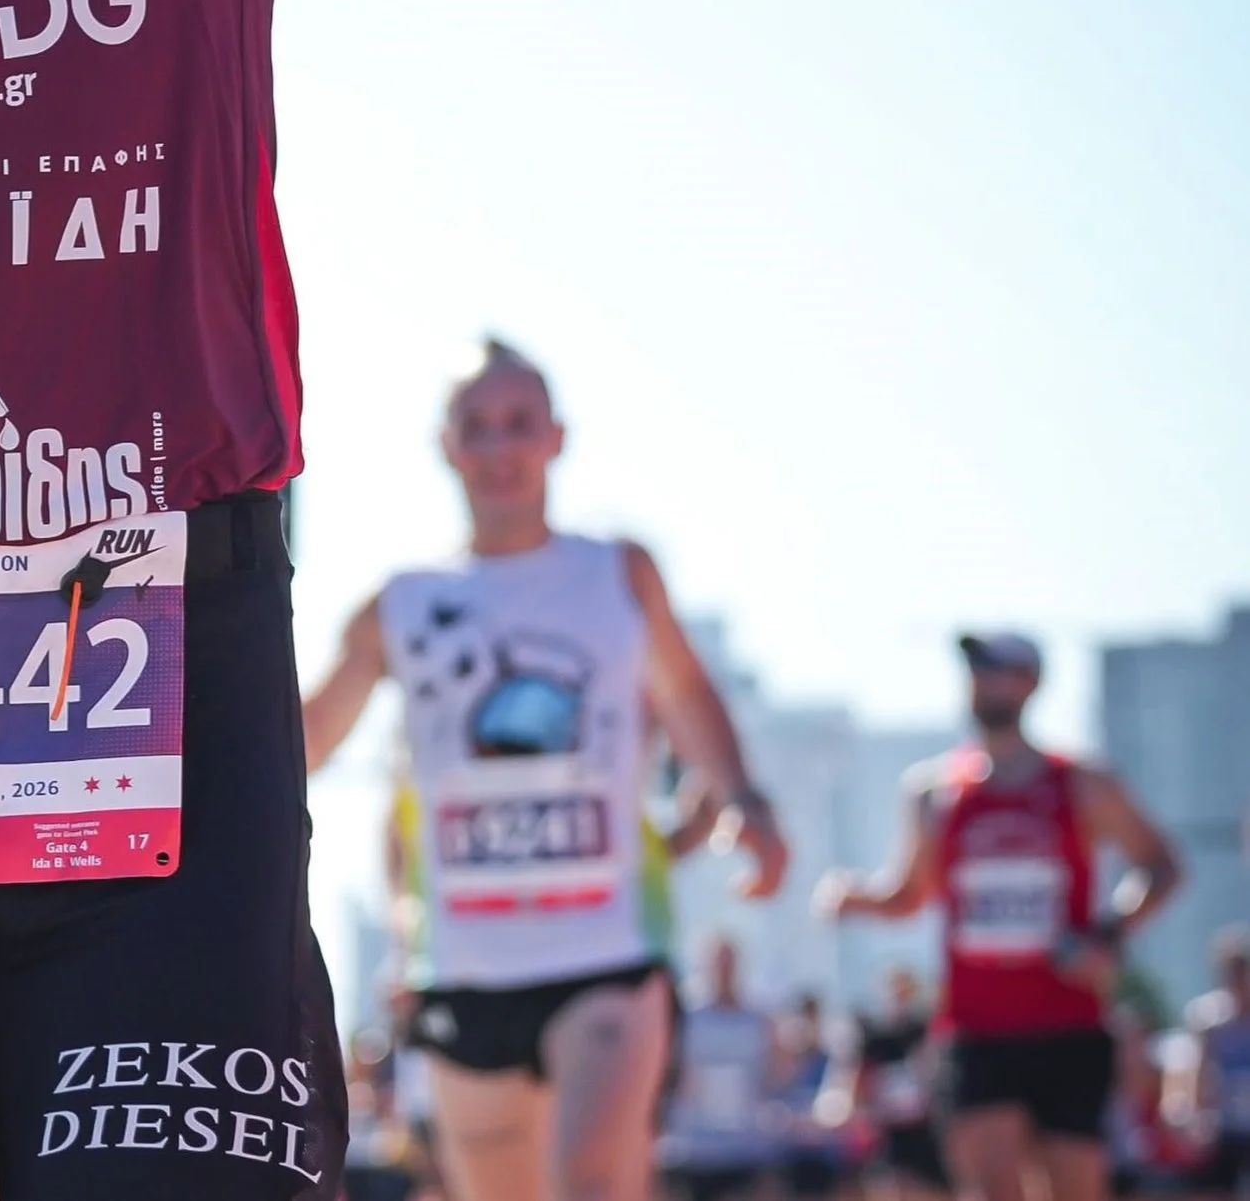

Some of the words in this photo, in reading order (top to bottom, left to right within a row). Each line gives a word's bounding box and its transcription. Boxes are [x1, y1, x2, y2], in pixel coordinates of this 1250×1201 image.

[38, 143, 165, 173] ΕΠΑΦΗΣ
[152, 411, 164, 451] more
[150, 466, 169, 511] coffee
[95, 529, 156, 554] RUN
[11, 780, 60, 798] 2026
[46, 842, 77, 854] Gate
[79, 840, 88, 851] 4
[128, 833, 150, 850] 17
[32, 857, 51, 868] Ida
[69, 855, 102, 867] Wells
[53, 1042, 309, 1107] ZEKOS
[37, 1104, 322, 1184] DIESEL
